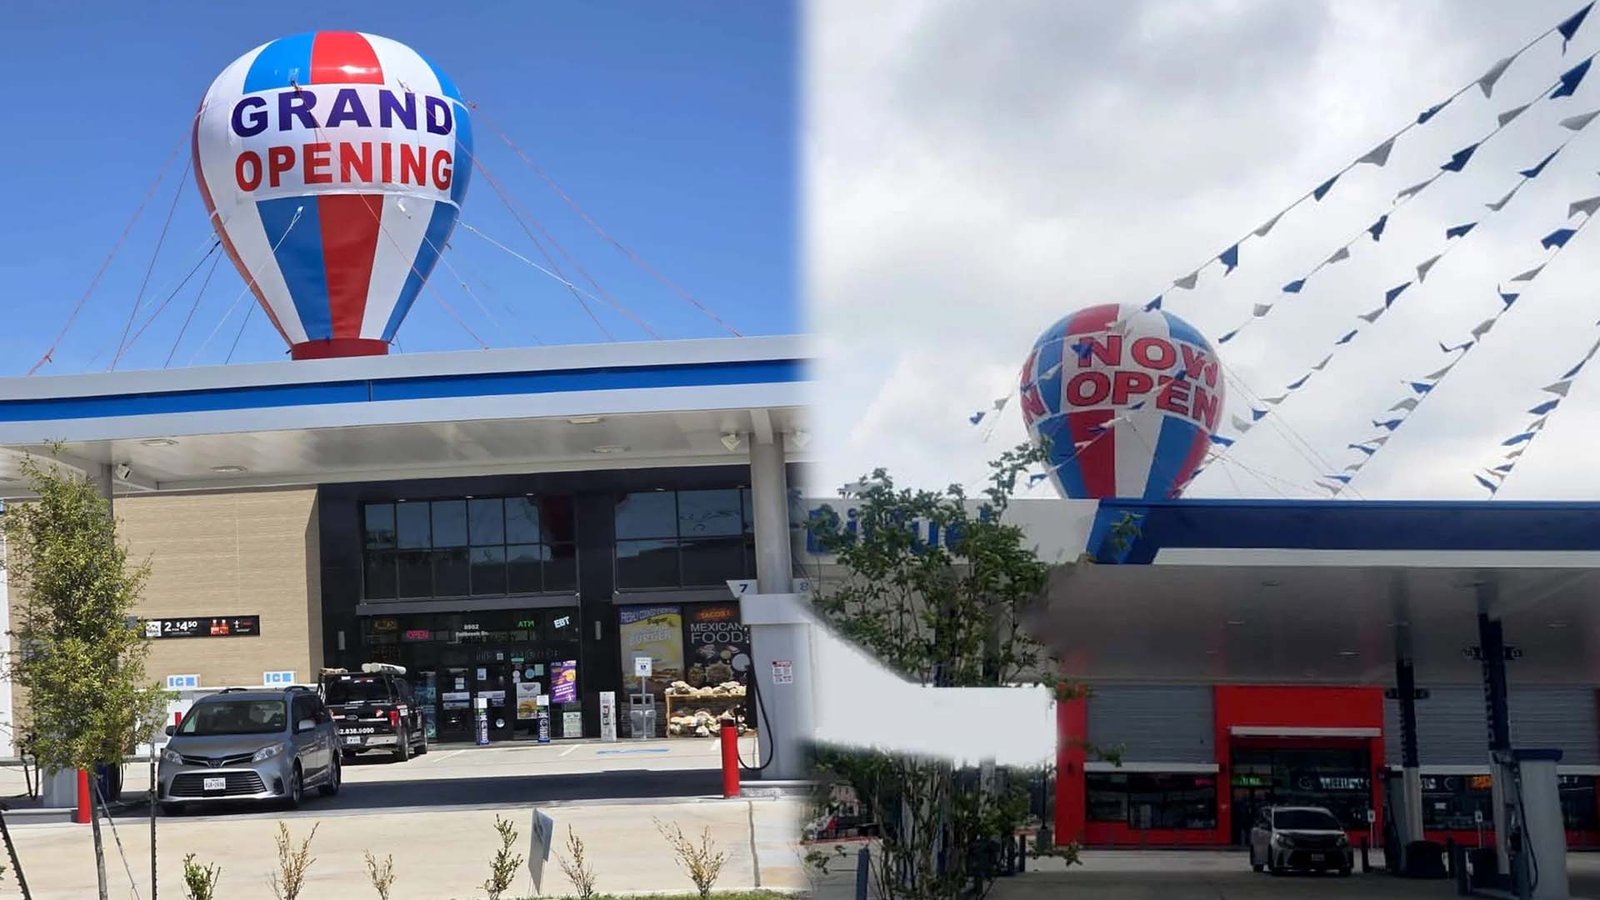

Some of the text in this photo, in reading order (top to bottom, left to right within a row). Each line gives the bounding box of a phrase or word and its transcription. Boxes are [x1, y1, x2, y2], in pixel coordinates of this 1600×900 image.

[231, 88, 452, 138] GRAND
[235, 141, 452, 193] OPENING
[1077, 334, 1219, 389] NOW
[1066, 370, 1219, 433] OPEN
[739, 583, 749, 593] 7
[164, 621, 172, 632] 2
[517, 620, 535, 628] ATM
[553, 616, 570, 629] EBT
[690, 621, 743, 632] MEXICAN
[690, 631, 744, 644] FOOD
